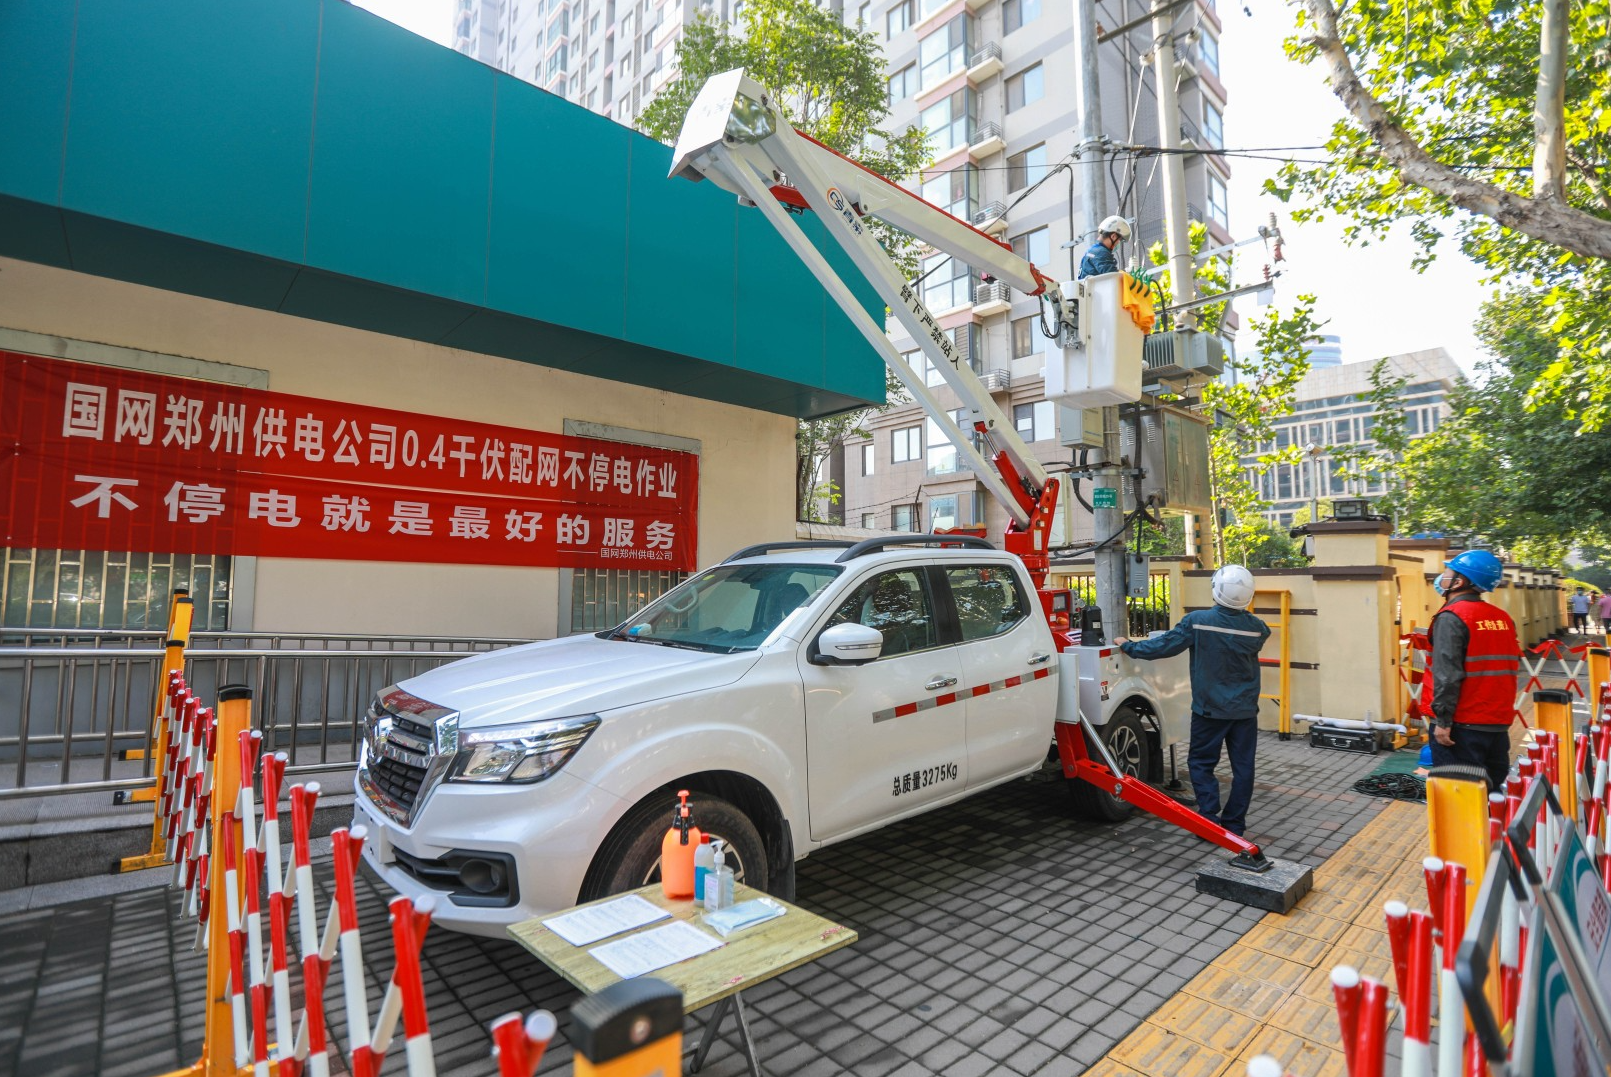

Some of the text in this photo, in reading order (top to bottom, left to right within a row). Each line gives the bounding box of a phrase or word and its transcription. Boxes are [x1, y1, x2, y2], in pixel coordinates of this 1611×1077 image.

[900, 284, 959, 370] 臂下严禁站人
[69, 474, 676, 550] 不停电就是最好的服务
[600, 547, 673, 561] 国网郑州供电公司
[892, 762, 958, 797] 总质量3275Kg
